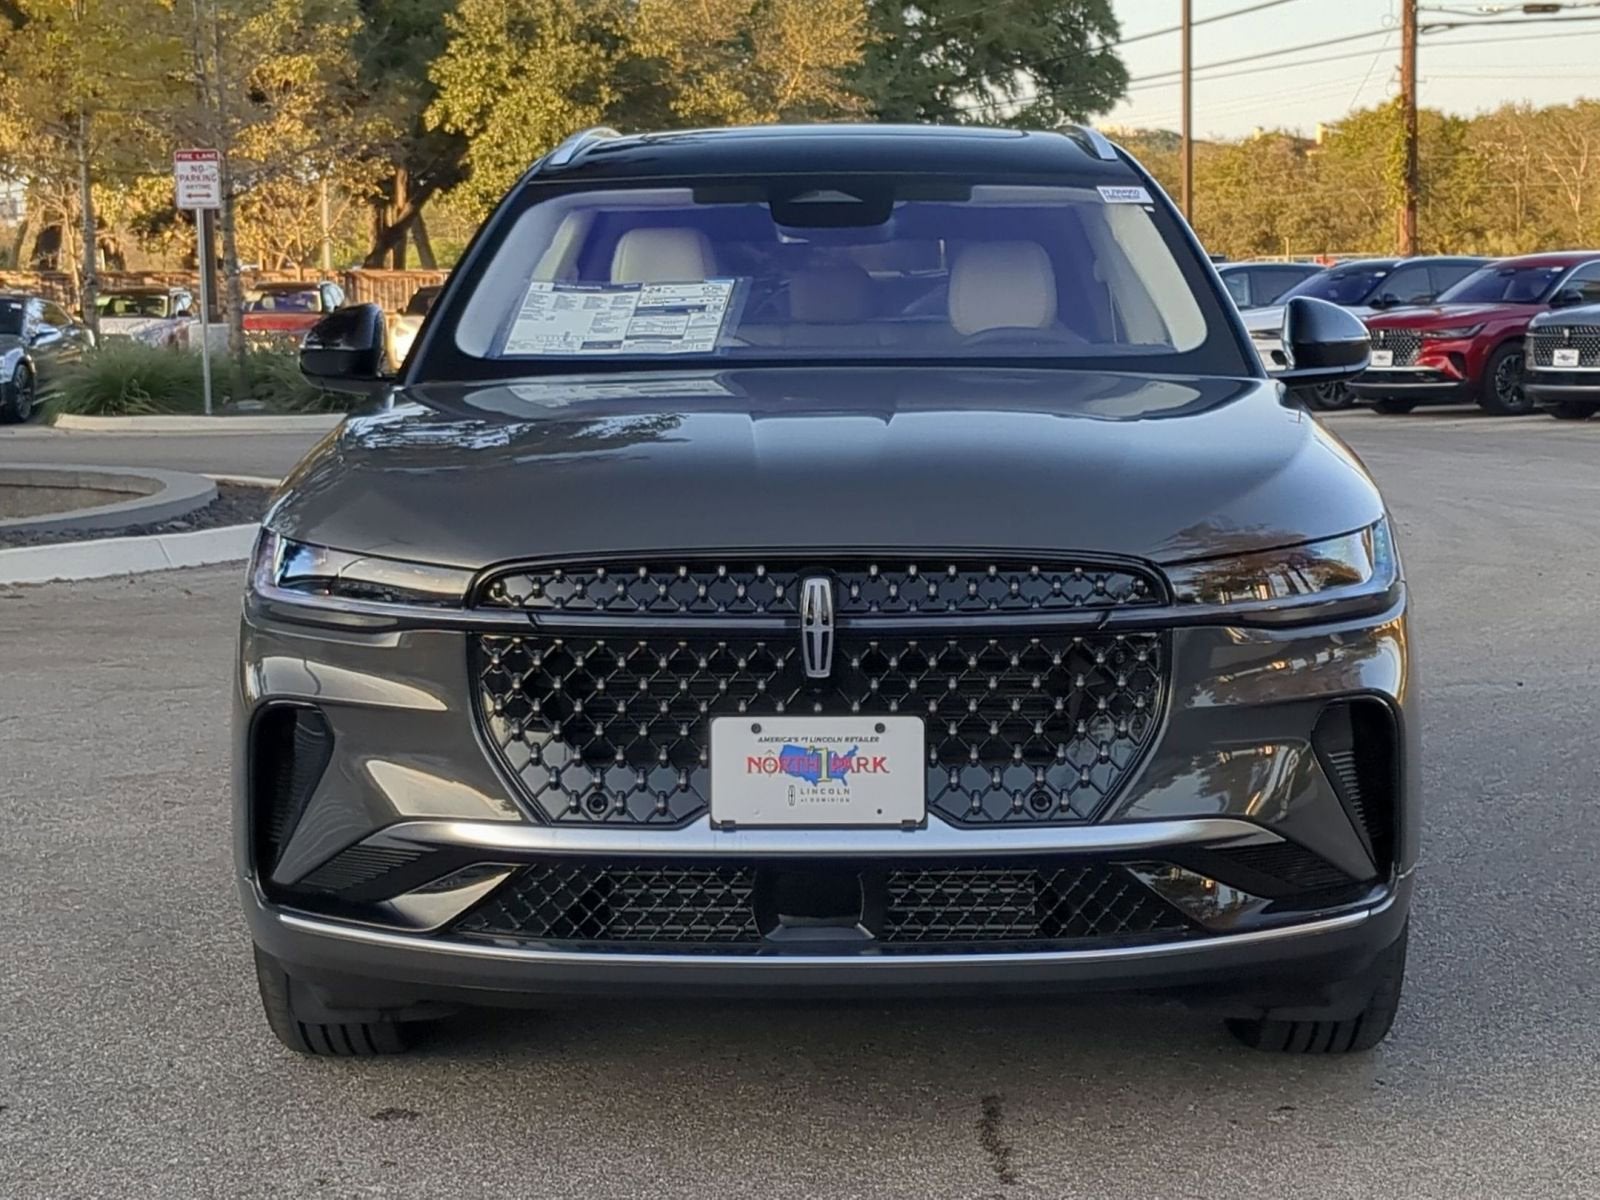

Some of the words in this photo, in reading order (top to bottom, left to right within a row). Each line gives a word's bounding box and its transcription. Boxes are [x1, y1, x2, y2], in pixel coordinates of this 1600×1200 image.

[191, 164, 204, 172] NO
[179, 174, 217, 183] PARKING
[746, 756, 819, 774] NORTH
[831, 756, 890, 774] PARK
[800, 788, 850, 796] LINCOLN
